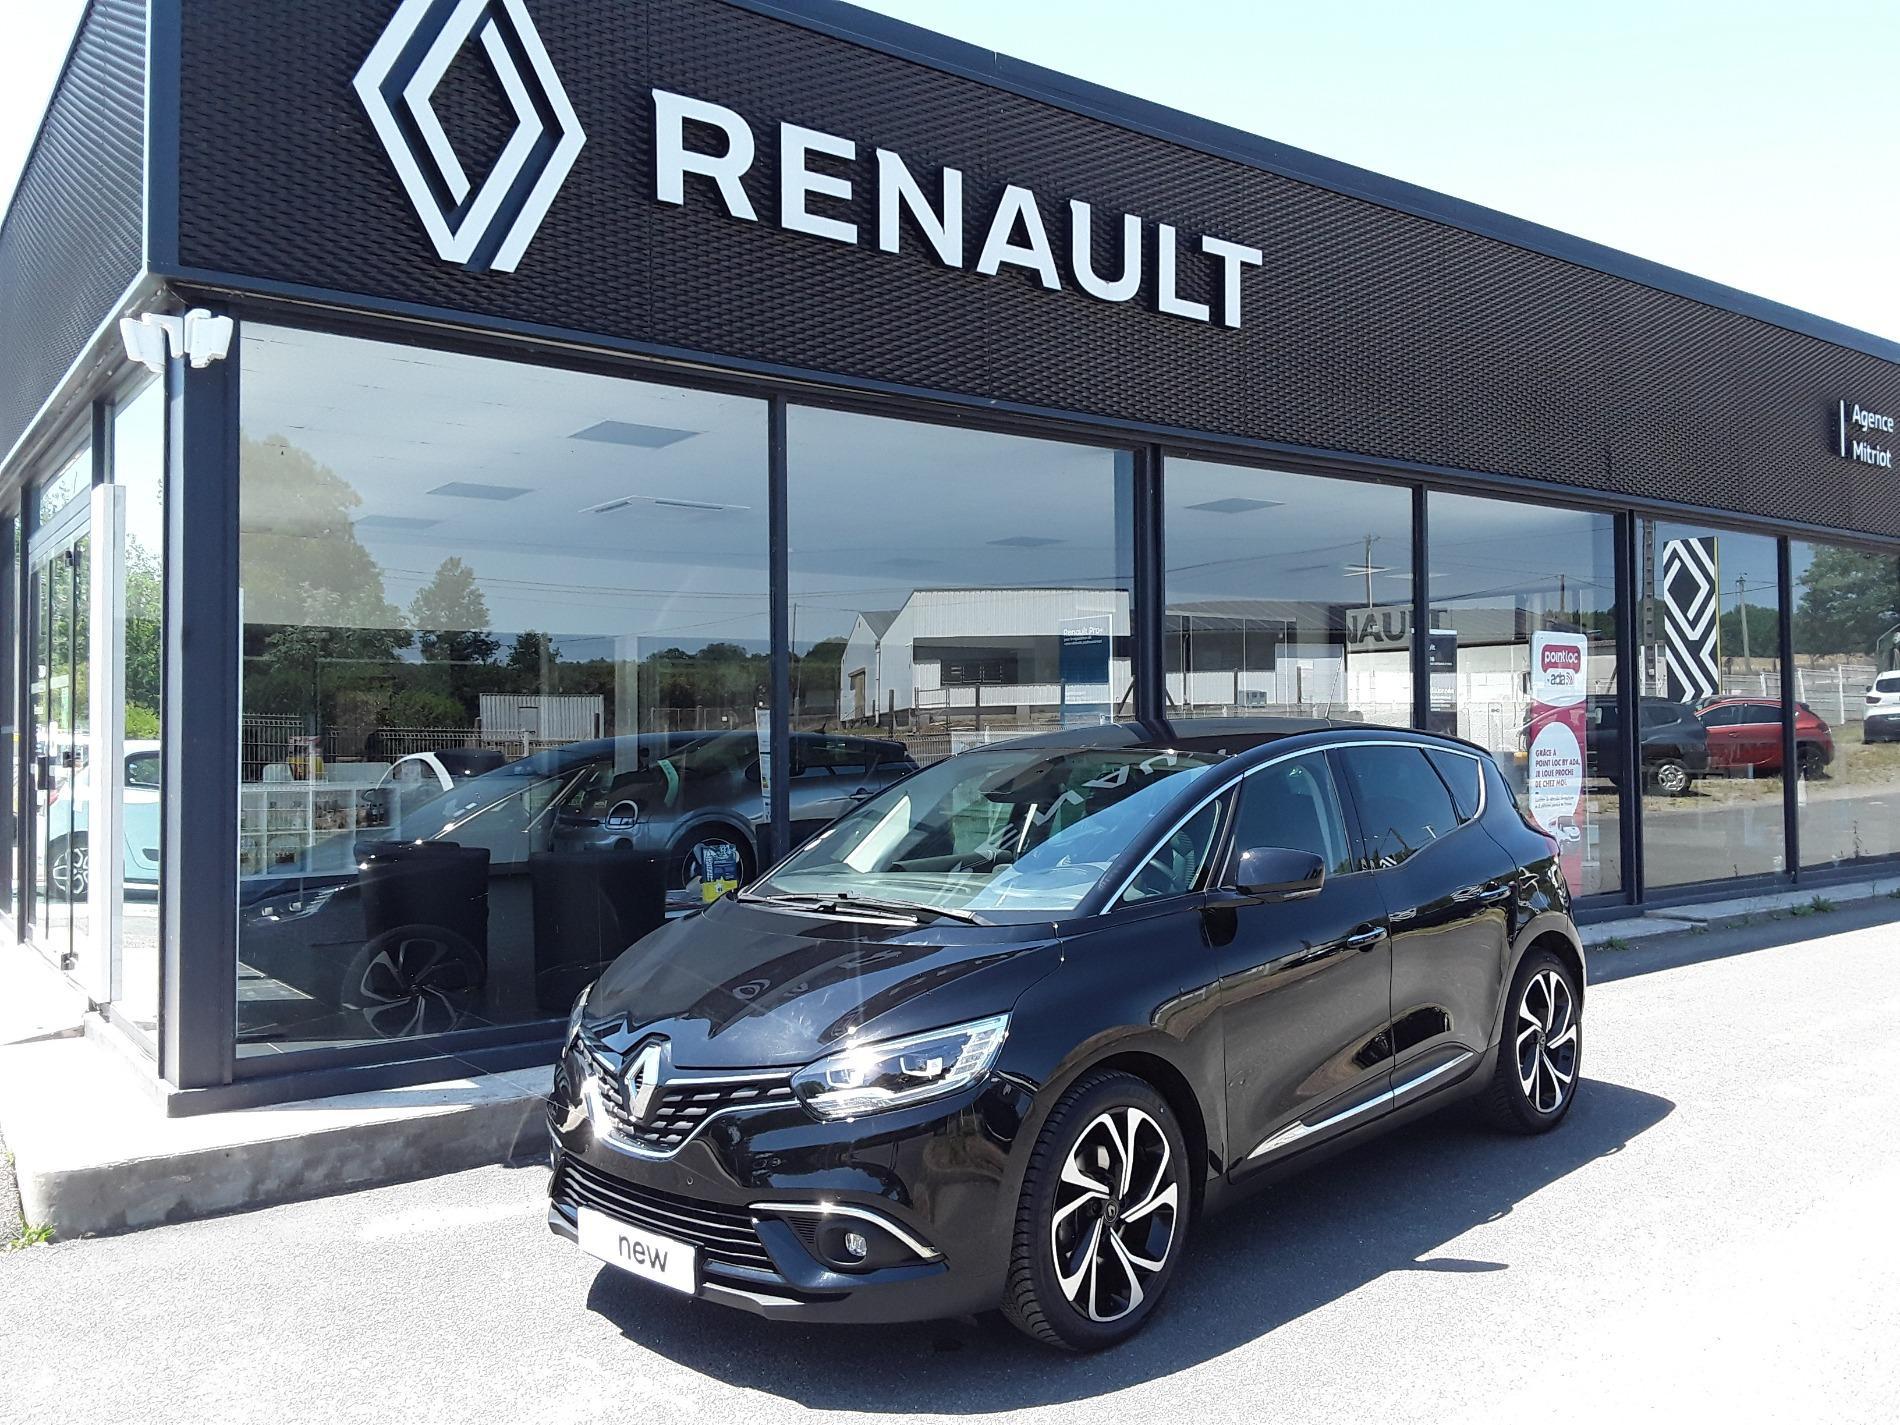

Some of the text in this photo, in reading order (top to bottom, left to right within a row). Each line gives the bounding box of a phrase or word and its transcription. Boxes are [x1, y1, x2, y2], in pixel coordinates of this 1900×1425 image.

[652, 88, 1263, 329] RENAULT
[1852, 404, 1895, 432] Agence
[1852, 440, 1892, 468] Mitriot
[1535, 759, 1551, 767] POINT
[1552, 758, 1561, 767] LOC
[1562, 758, 1569, 766] BY
[1535, 768, 1574, 778] JE LOUE PROCHE
[1535, 780, 1542, 788] DE
[1543, 779, 1555, 788] CHEZ
[618, 1234, 668, 1273] new
